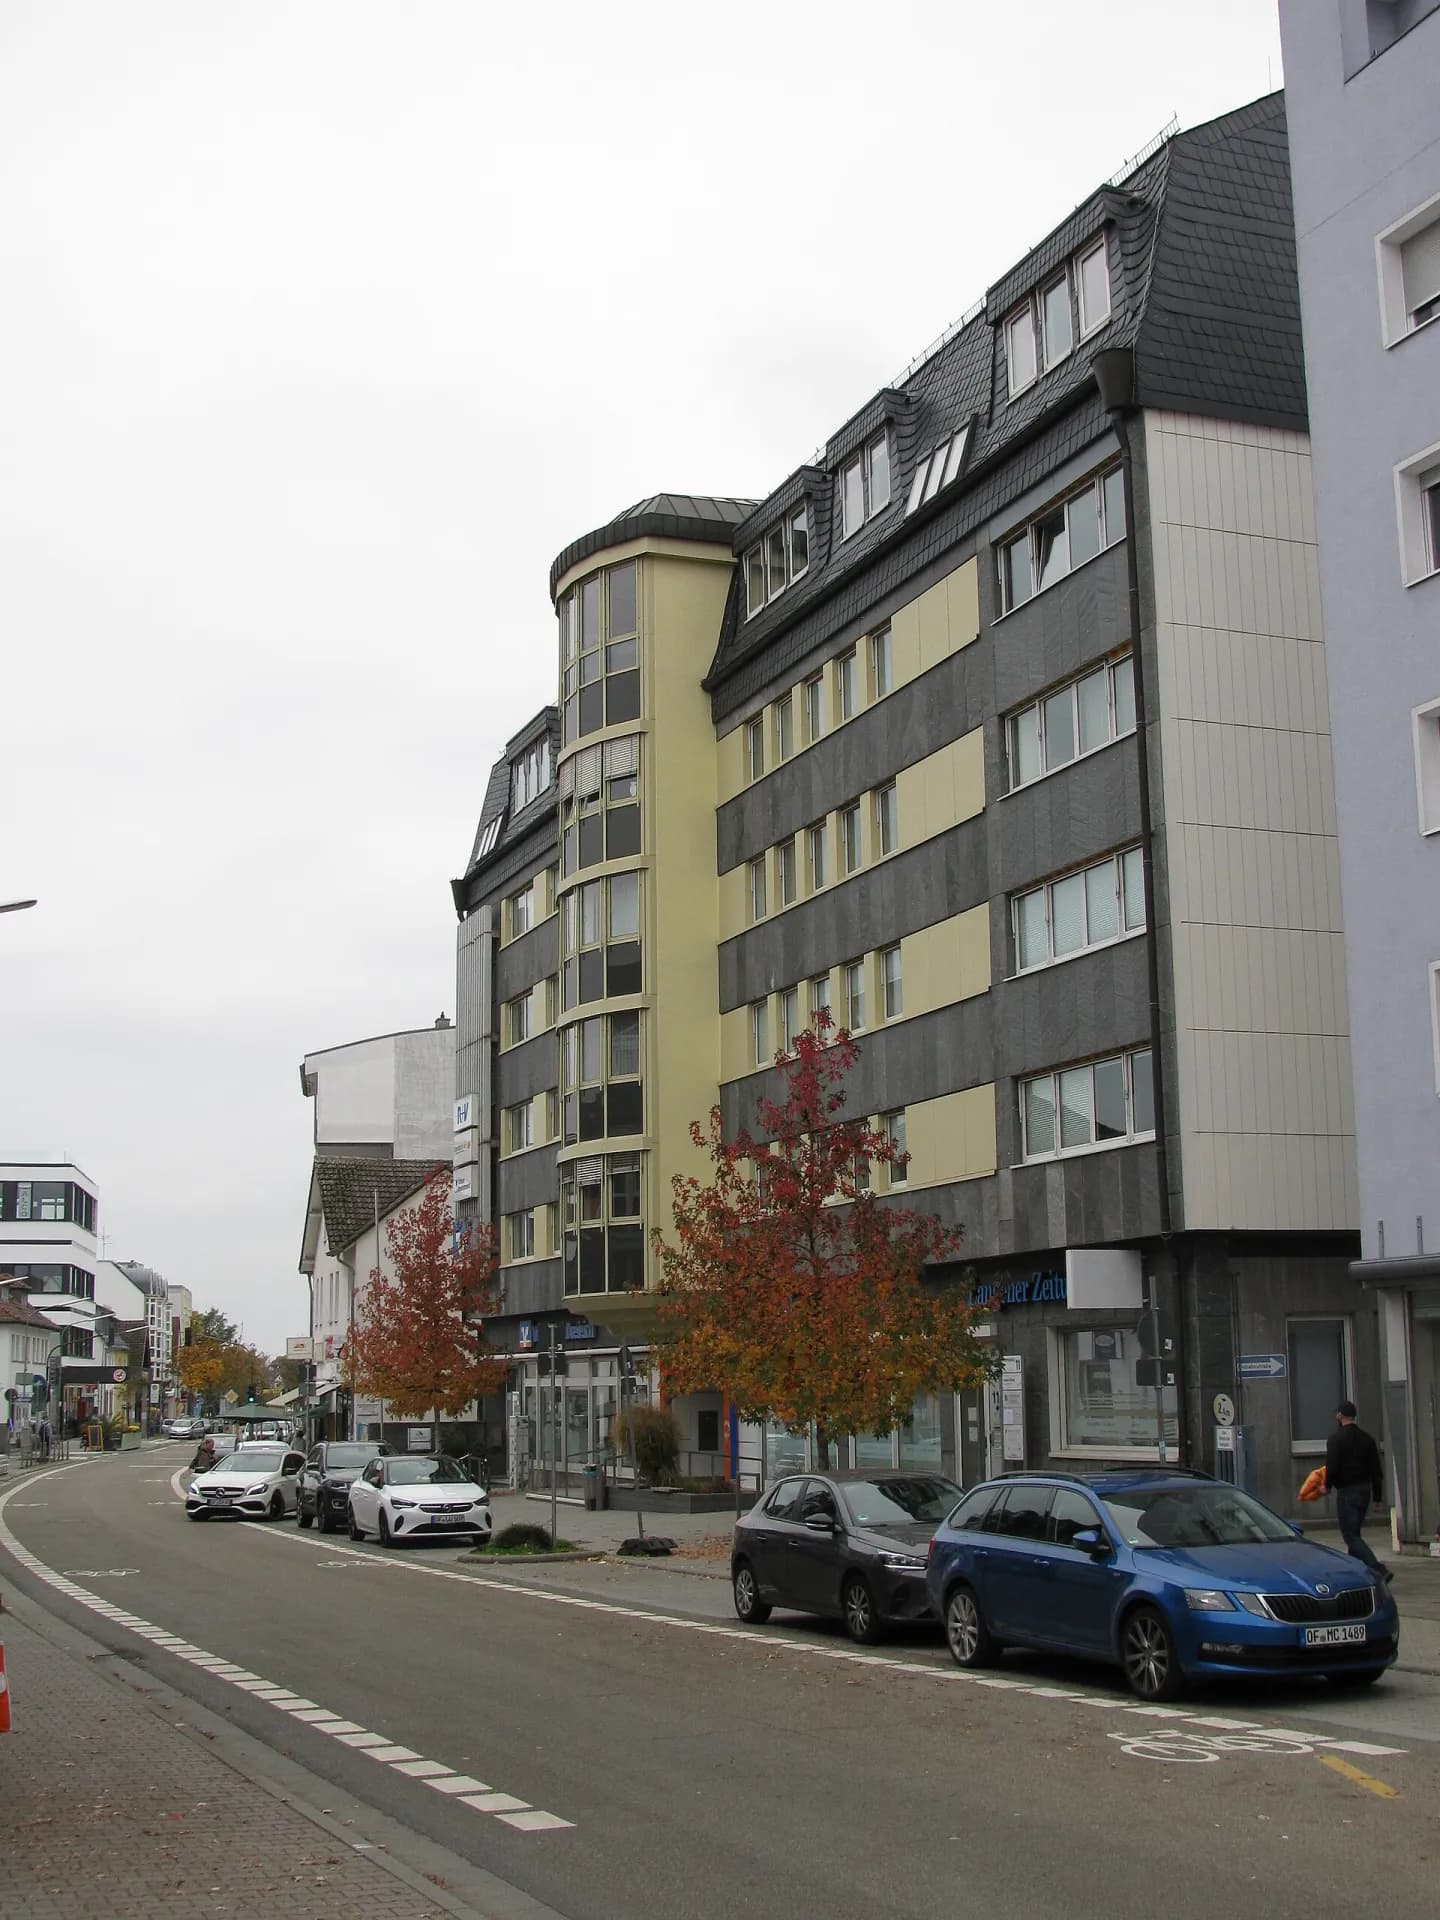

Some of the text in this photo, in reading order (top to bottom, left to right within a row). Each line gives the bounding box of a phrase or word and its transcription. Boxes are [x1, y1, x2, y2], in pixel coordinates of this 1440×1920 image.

[1031, 1270, 1066, 1301] Zeitu
[992, 1391, 1000, 1404] 11
[1306, 1625, 1365, 1643] OF MC 1489
